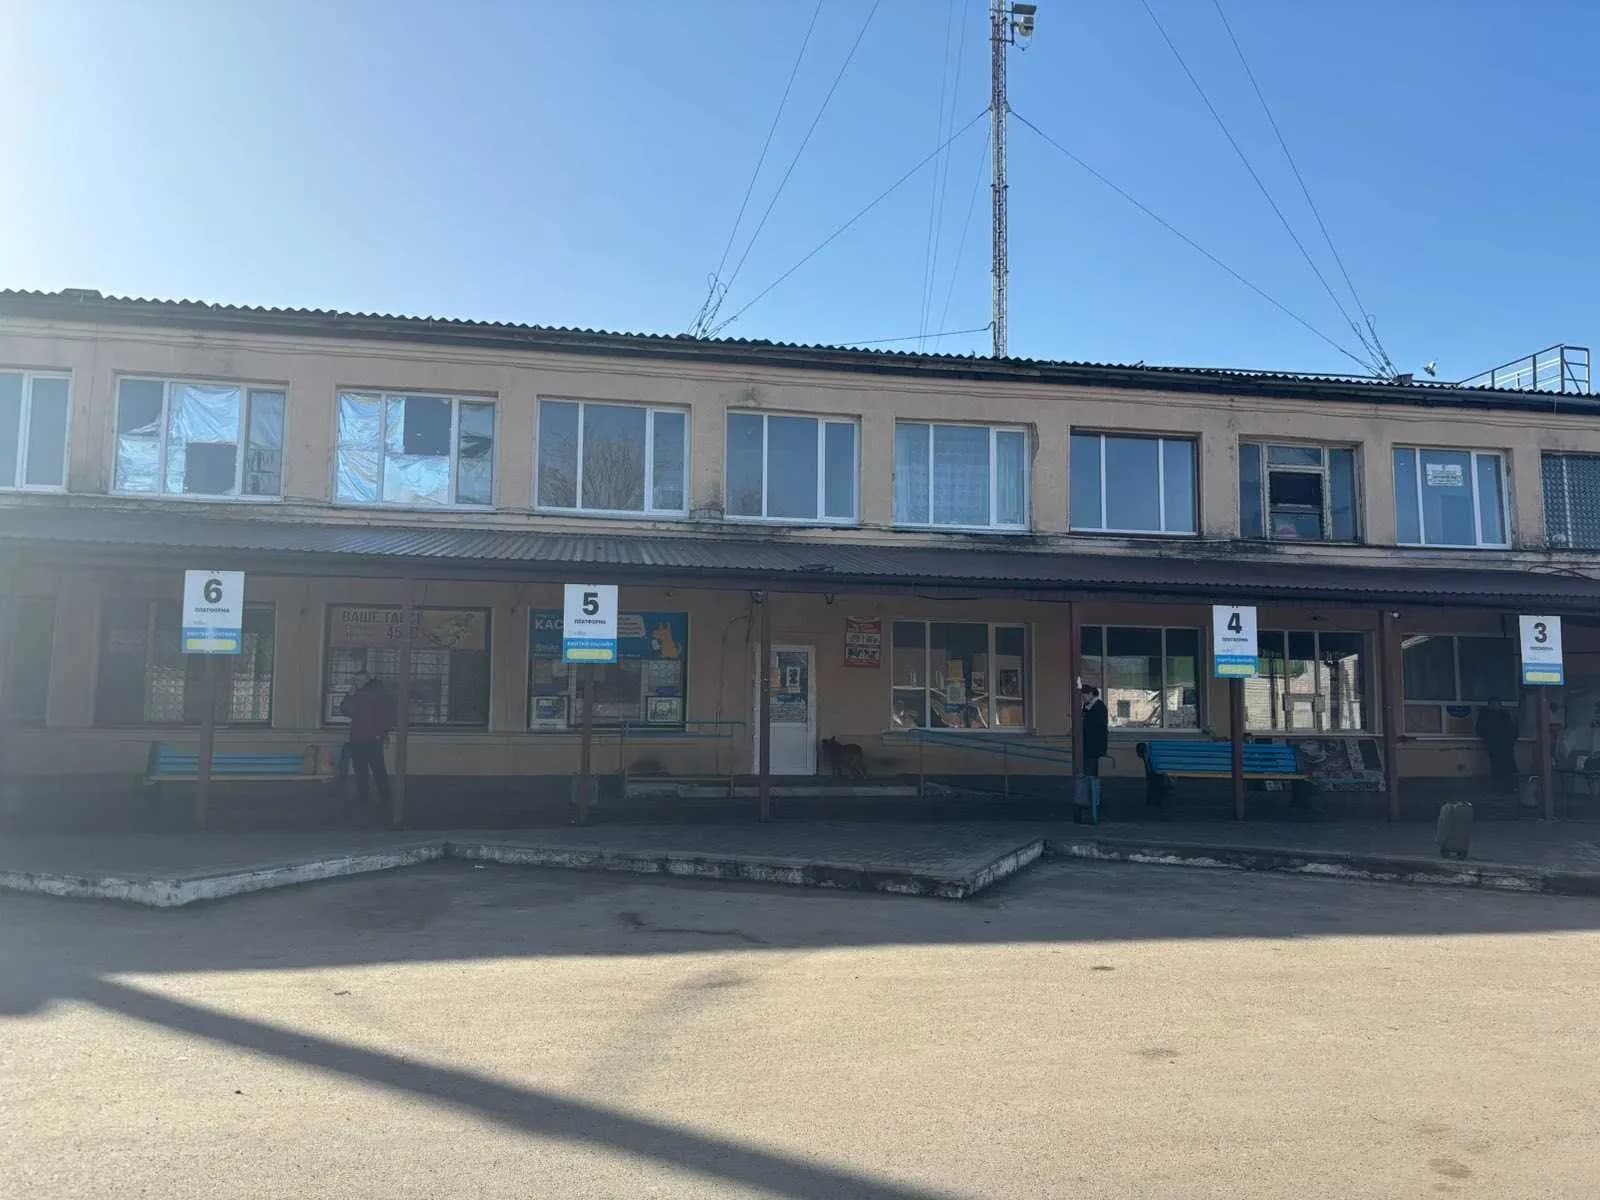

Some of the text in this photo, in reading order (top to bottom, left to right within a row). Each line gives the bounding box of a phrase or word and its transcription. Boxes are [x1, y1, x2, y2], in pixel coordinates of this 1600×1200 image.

[204, 578, 223, 603] 6
[582, 592, 599, 615] 5
[535, 619, 564, 630] КАС
[1227, 613, 1242, 634] 4
[1534, 622, 1547, 643] 3
